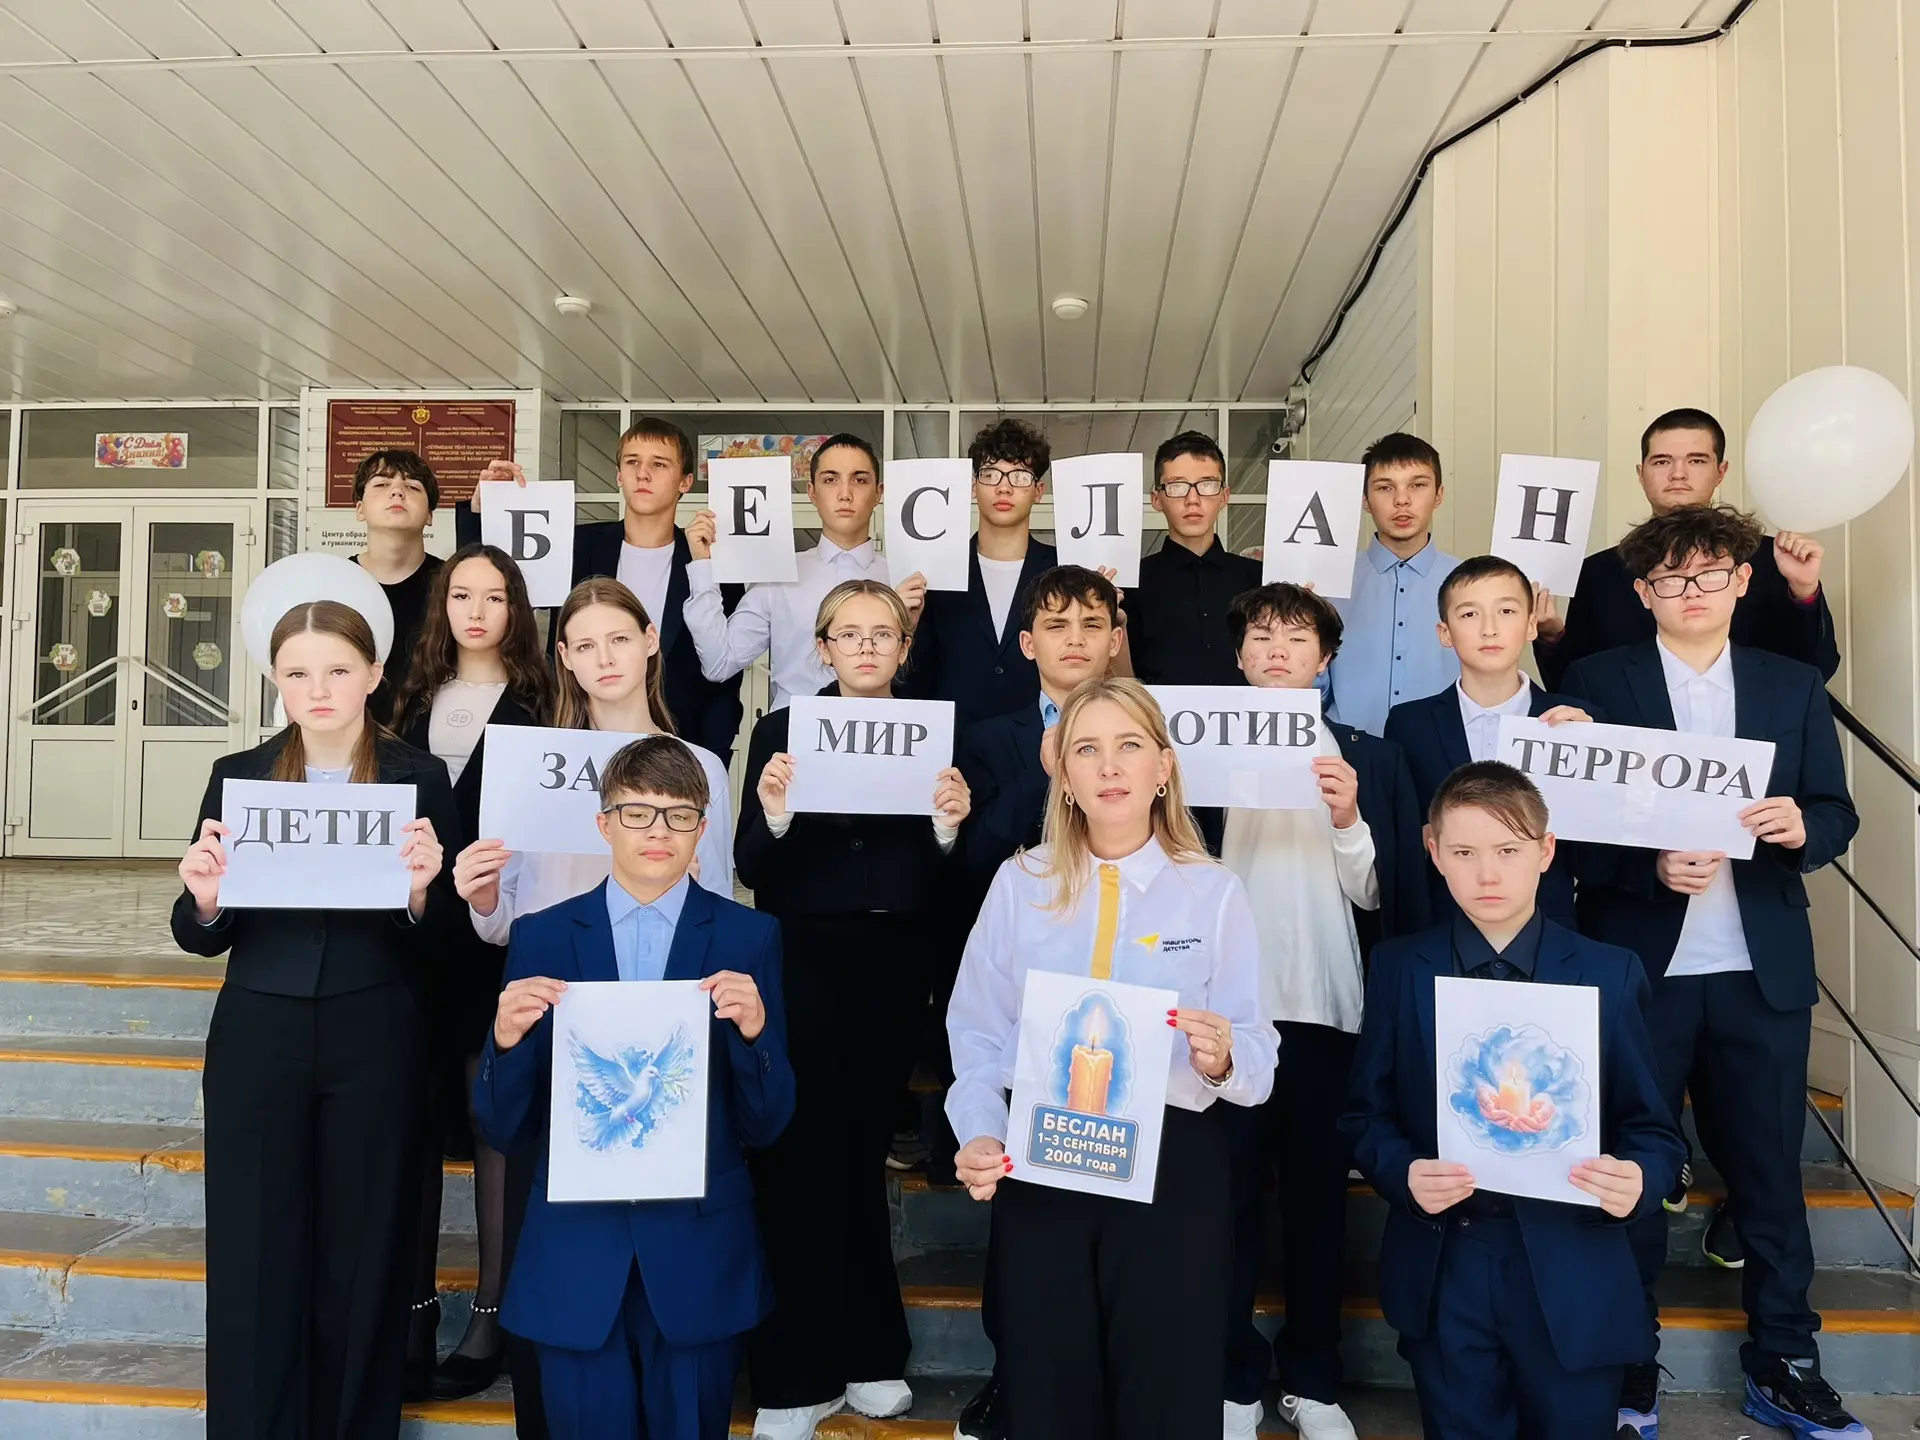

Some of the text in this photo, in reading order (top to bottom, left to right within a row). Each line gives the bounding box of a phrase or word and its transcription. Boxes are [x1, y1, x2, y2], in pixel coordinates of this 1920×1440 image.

[505, 509, 551, 561] Б
[728, 485, 771, 537] Е
[900, 486, 950, 541] С
[1070, 483, 1125, 540] Л
[1282, 490, 1339, 548] А
[1510, 484, 1579, 546] Н
[814, 718, 928, 757] МИР
[1168, 710, 1317, 748] ОТИВ
[539, 751, 600, 792] ЗА
[1511, 737, 1756, 800] ТЕРРОРА
[233, 806, 396, 853] ДЕТИ
[1042, 1112, 1126, 1144] БЕСЛАН
[1063, 1136, 1127, 1159] СЕНТЯБРЯ
[1044, 1147, 1117, 1172] 2004 года
